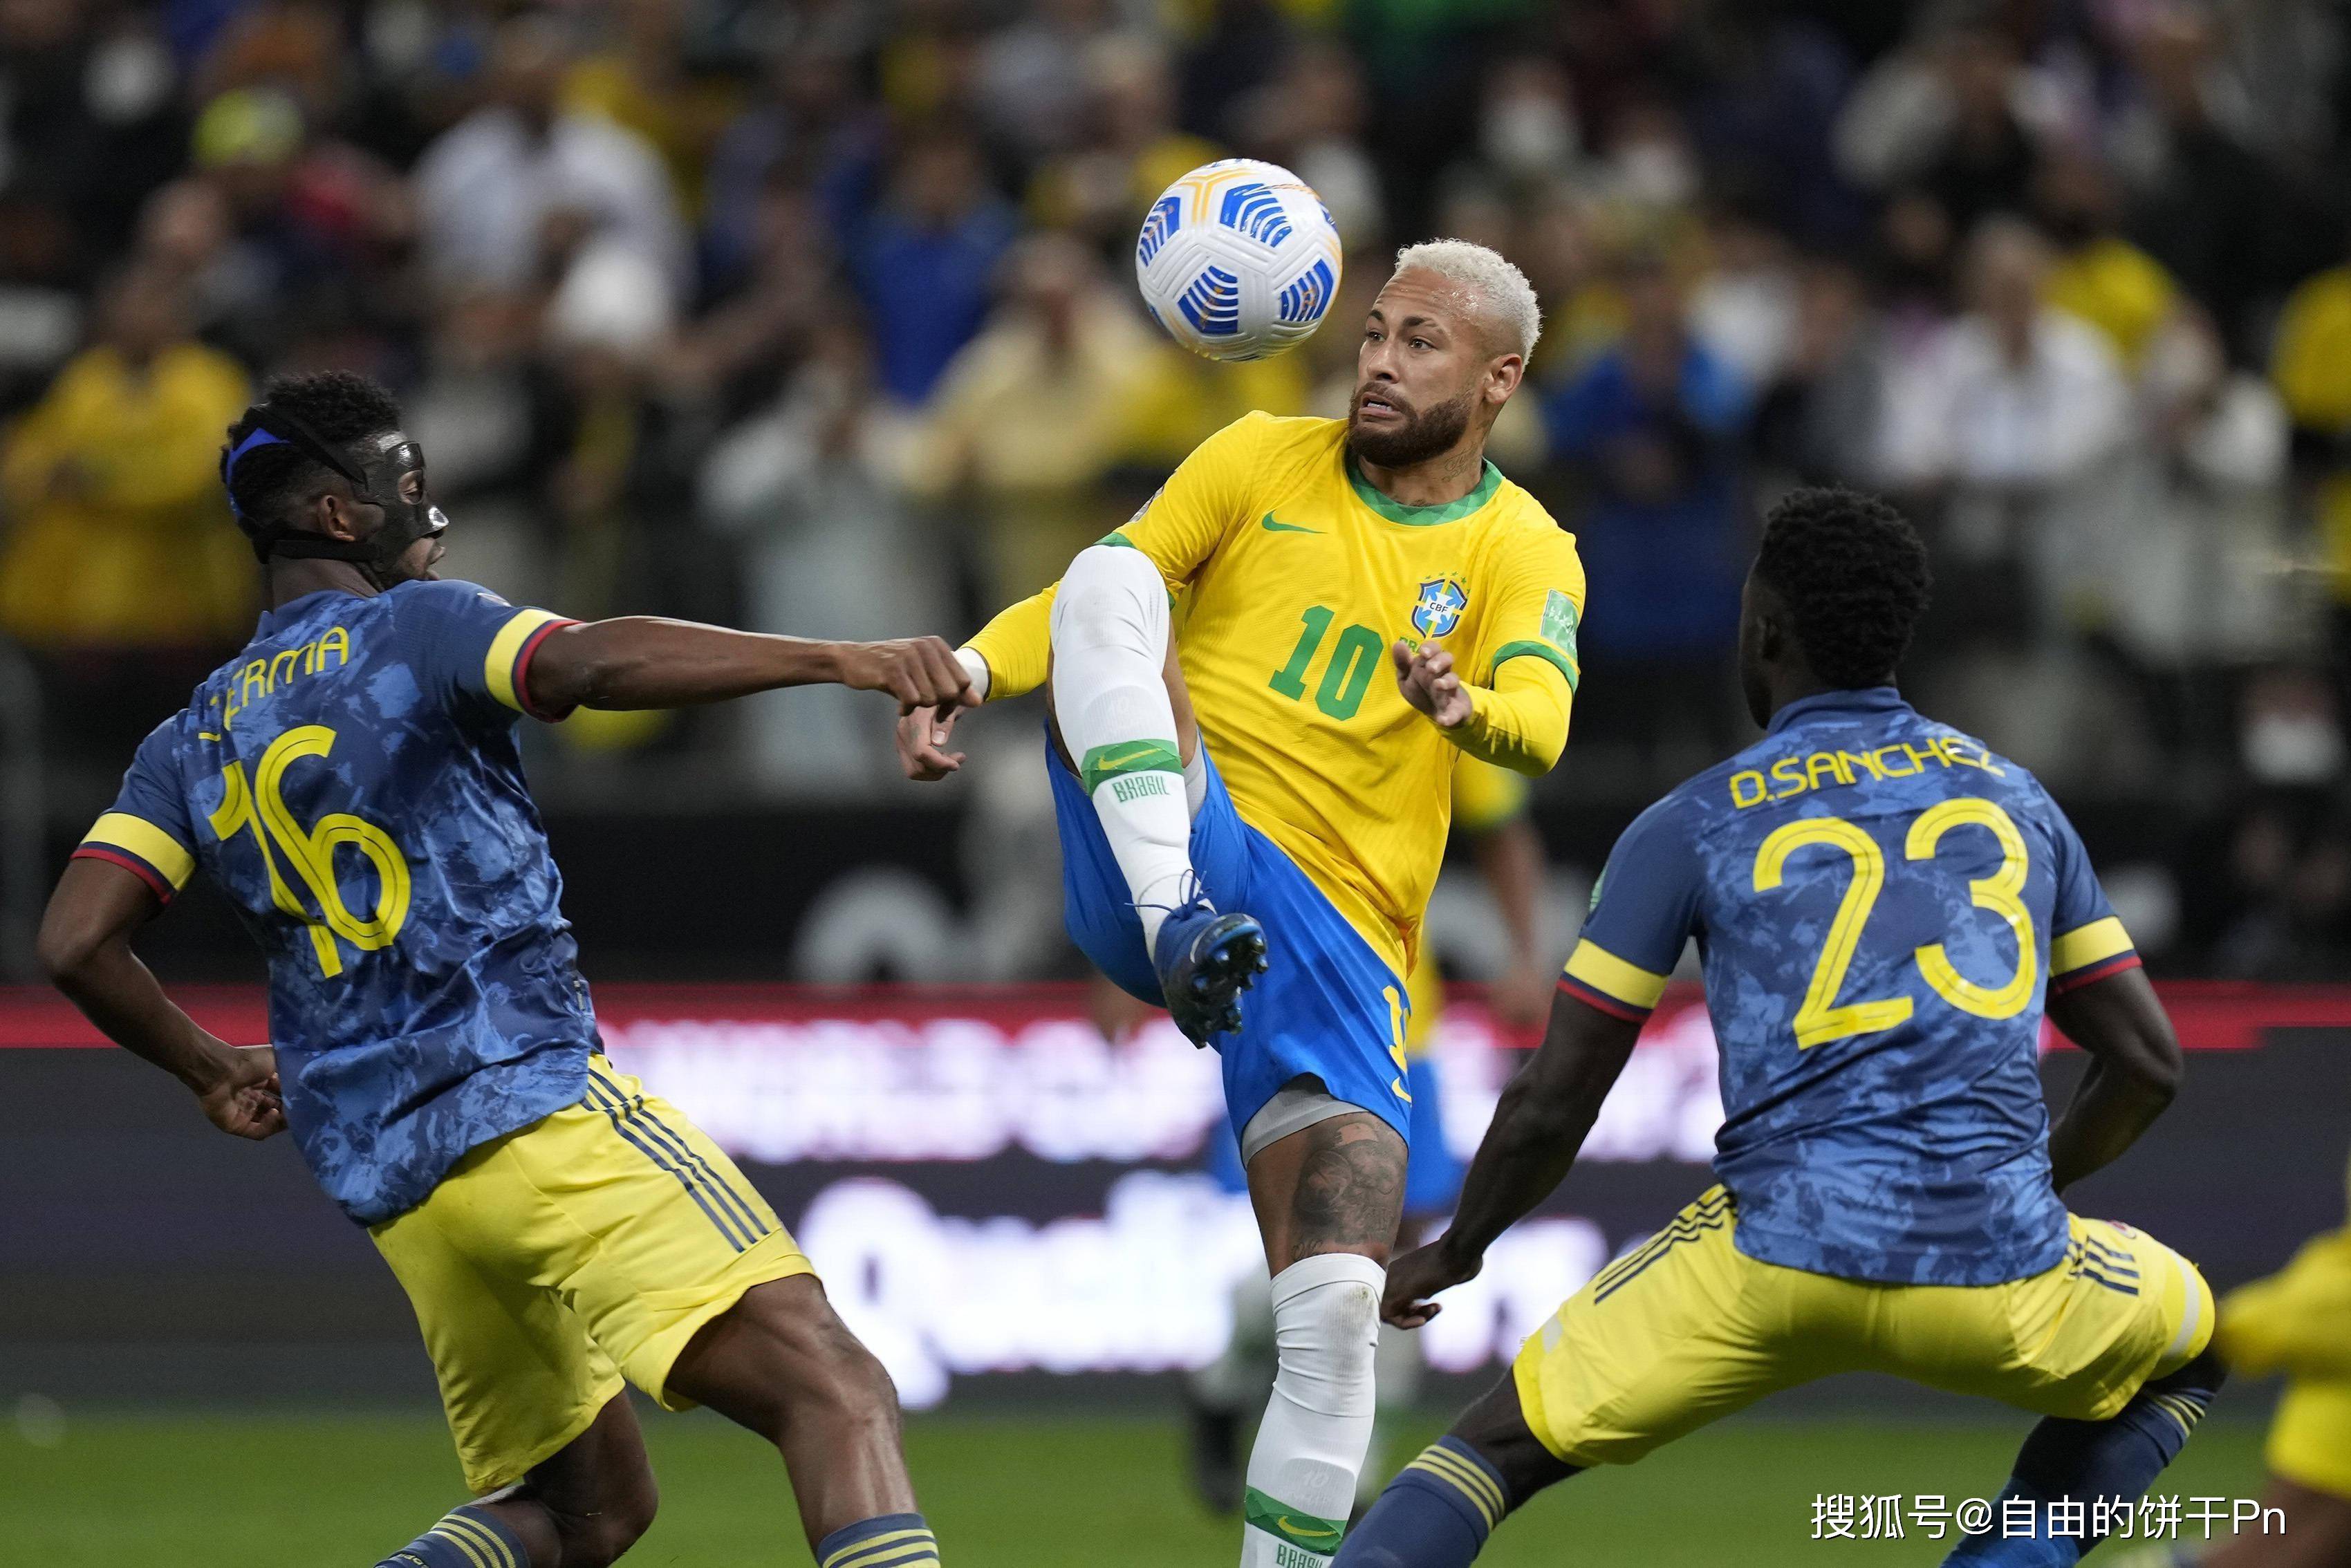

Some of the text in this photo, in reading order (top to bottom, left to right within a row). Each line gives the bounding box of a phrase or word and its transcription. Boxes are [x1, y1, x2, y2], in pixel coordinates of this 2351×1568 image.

[1429, 602, 1448, 613] CBF
[1268, 605, 1384, 721] 10
[1112, 775, 1170, 803] BRASIL
[1730, 736, 2005, 809] D.SANCHEZ
[208, 725, 411, 978] 16
[1752, 797, 2037, 1051] 23
[1382, 984, 1409, 1073] 1
